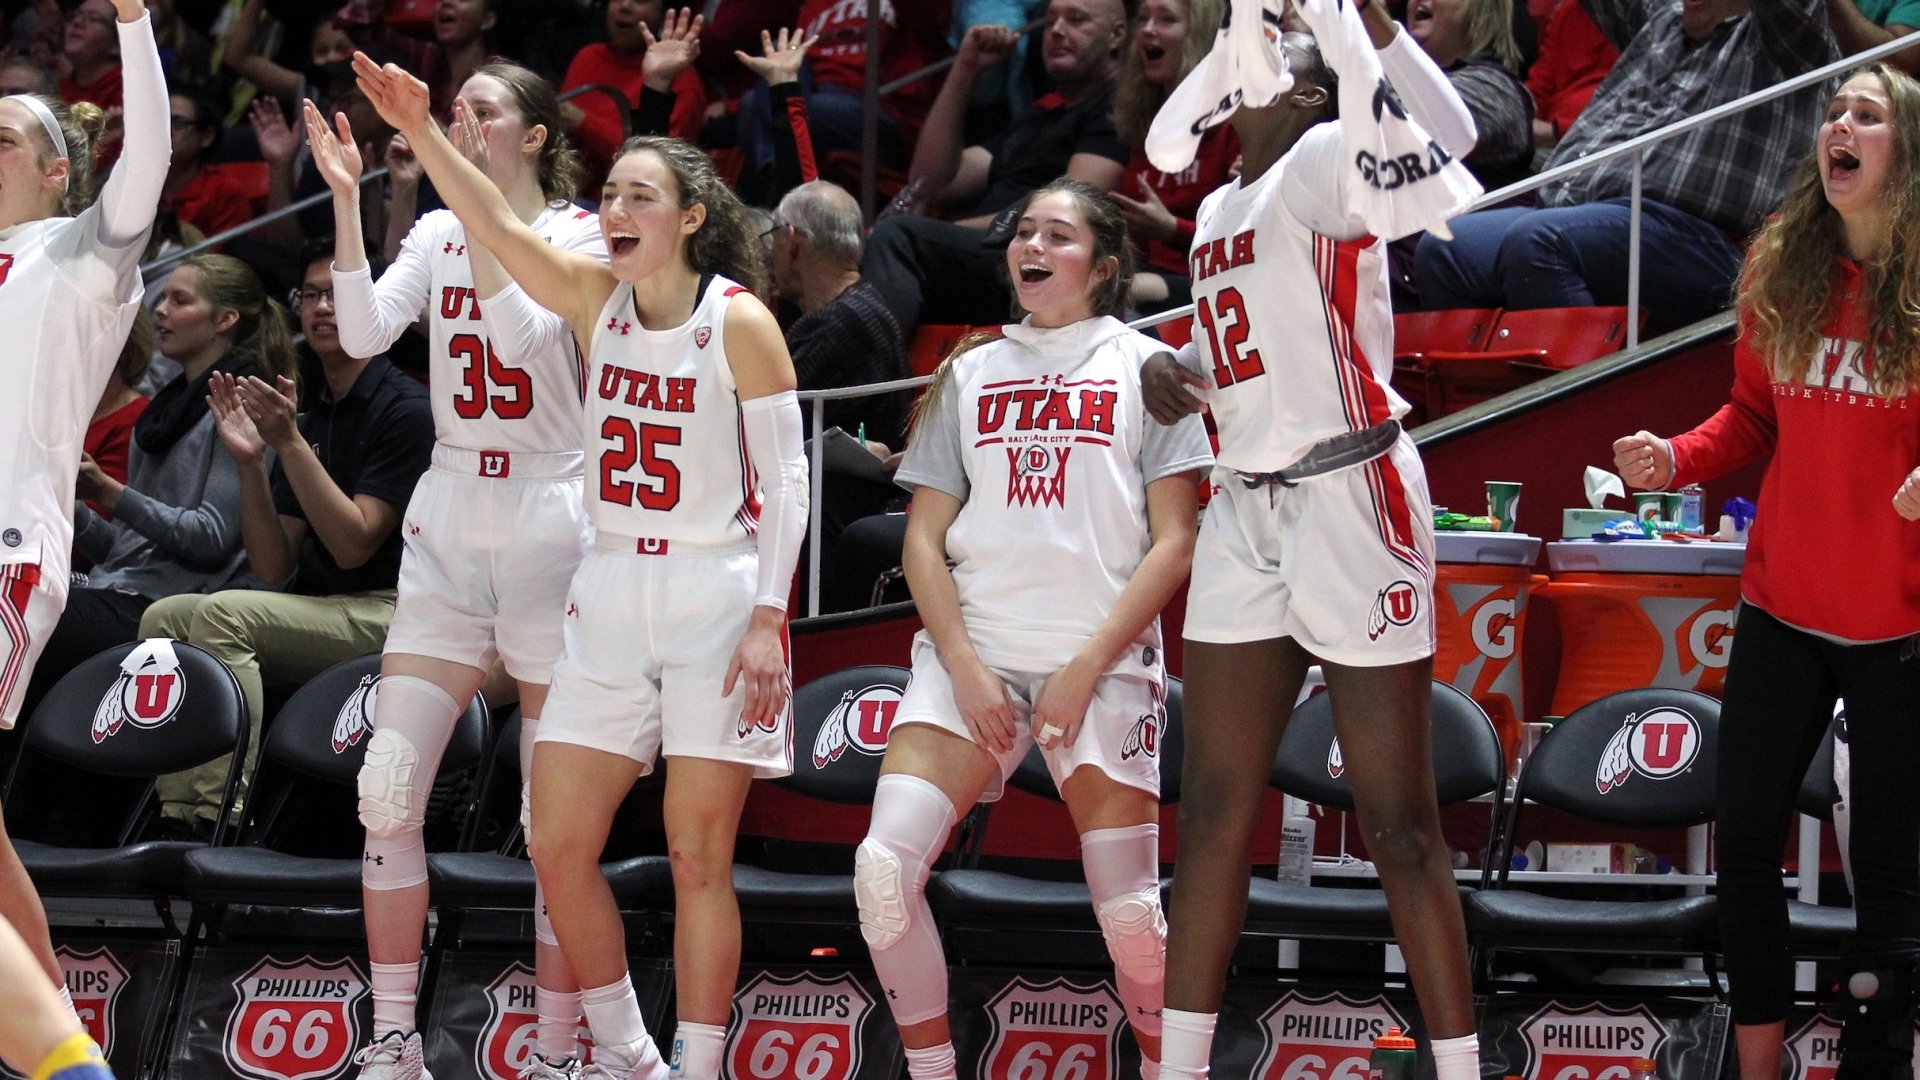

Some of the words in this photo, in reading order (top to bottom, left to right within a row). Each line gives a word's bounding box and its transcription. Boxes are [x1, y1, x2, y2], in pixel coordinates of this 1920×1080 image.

[440, 286, 482, 321] UT
[1197, 286, 1266, 390] 12
[449, 333, 534, 419] 35
[598, 363, 697, 413] UTAH
[977, 388, 1118, 436] UTAH
[1008, 435, 1028, 443] SALT
[1029, 434, 1048, 443] LAKE
[485, 456, 504, 476] U
[600, 415, 681, 511] 25
[1030, 450, 1045, 468] U
[1388, 589, 1412, 620] U
[1471, 598, 1516, 660] G
[1688, 609, 1735, 668] G
[135, 674, 176, 718] U
[858, 700, 900, 745] U
[1144, 721, 1157, 753] U
[1642, 723, 1689, 769] U
[65, 970, 110, 993] LIPS
[254, 978, 350, 998] PHILLIPS
[752, 994, 850, 1018] PHILLIPS
[1009, 1001, 1108, 1028] PHILLIPS
[250, 1008, 334, 1060] 66
[1282, 1014, 1384, 1042] PHILLIPS
[1543, 1024, 1645, 1050] PHILLIPS
[750, 1029, 840, 1080] 66
[1007, 1041, 1096, 1080] 66
